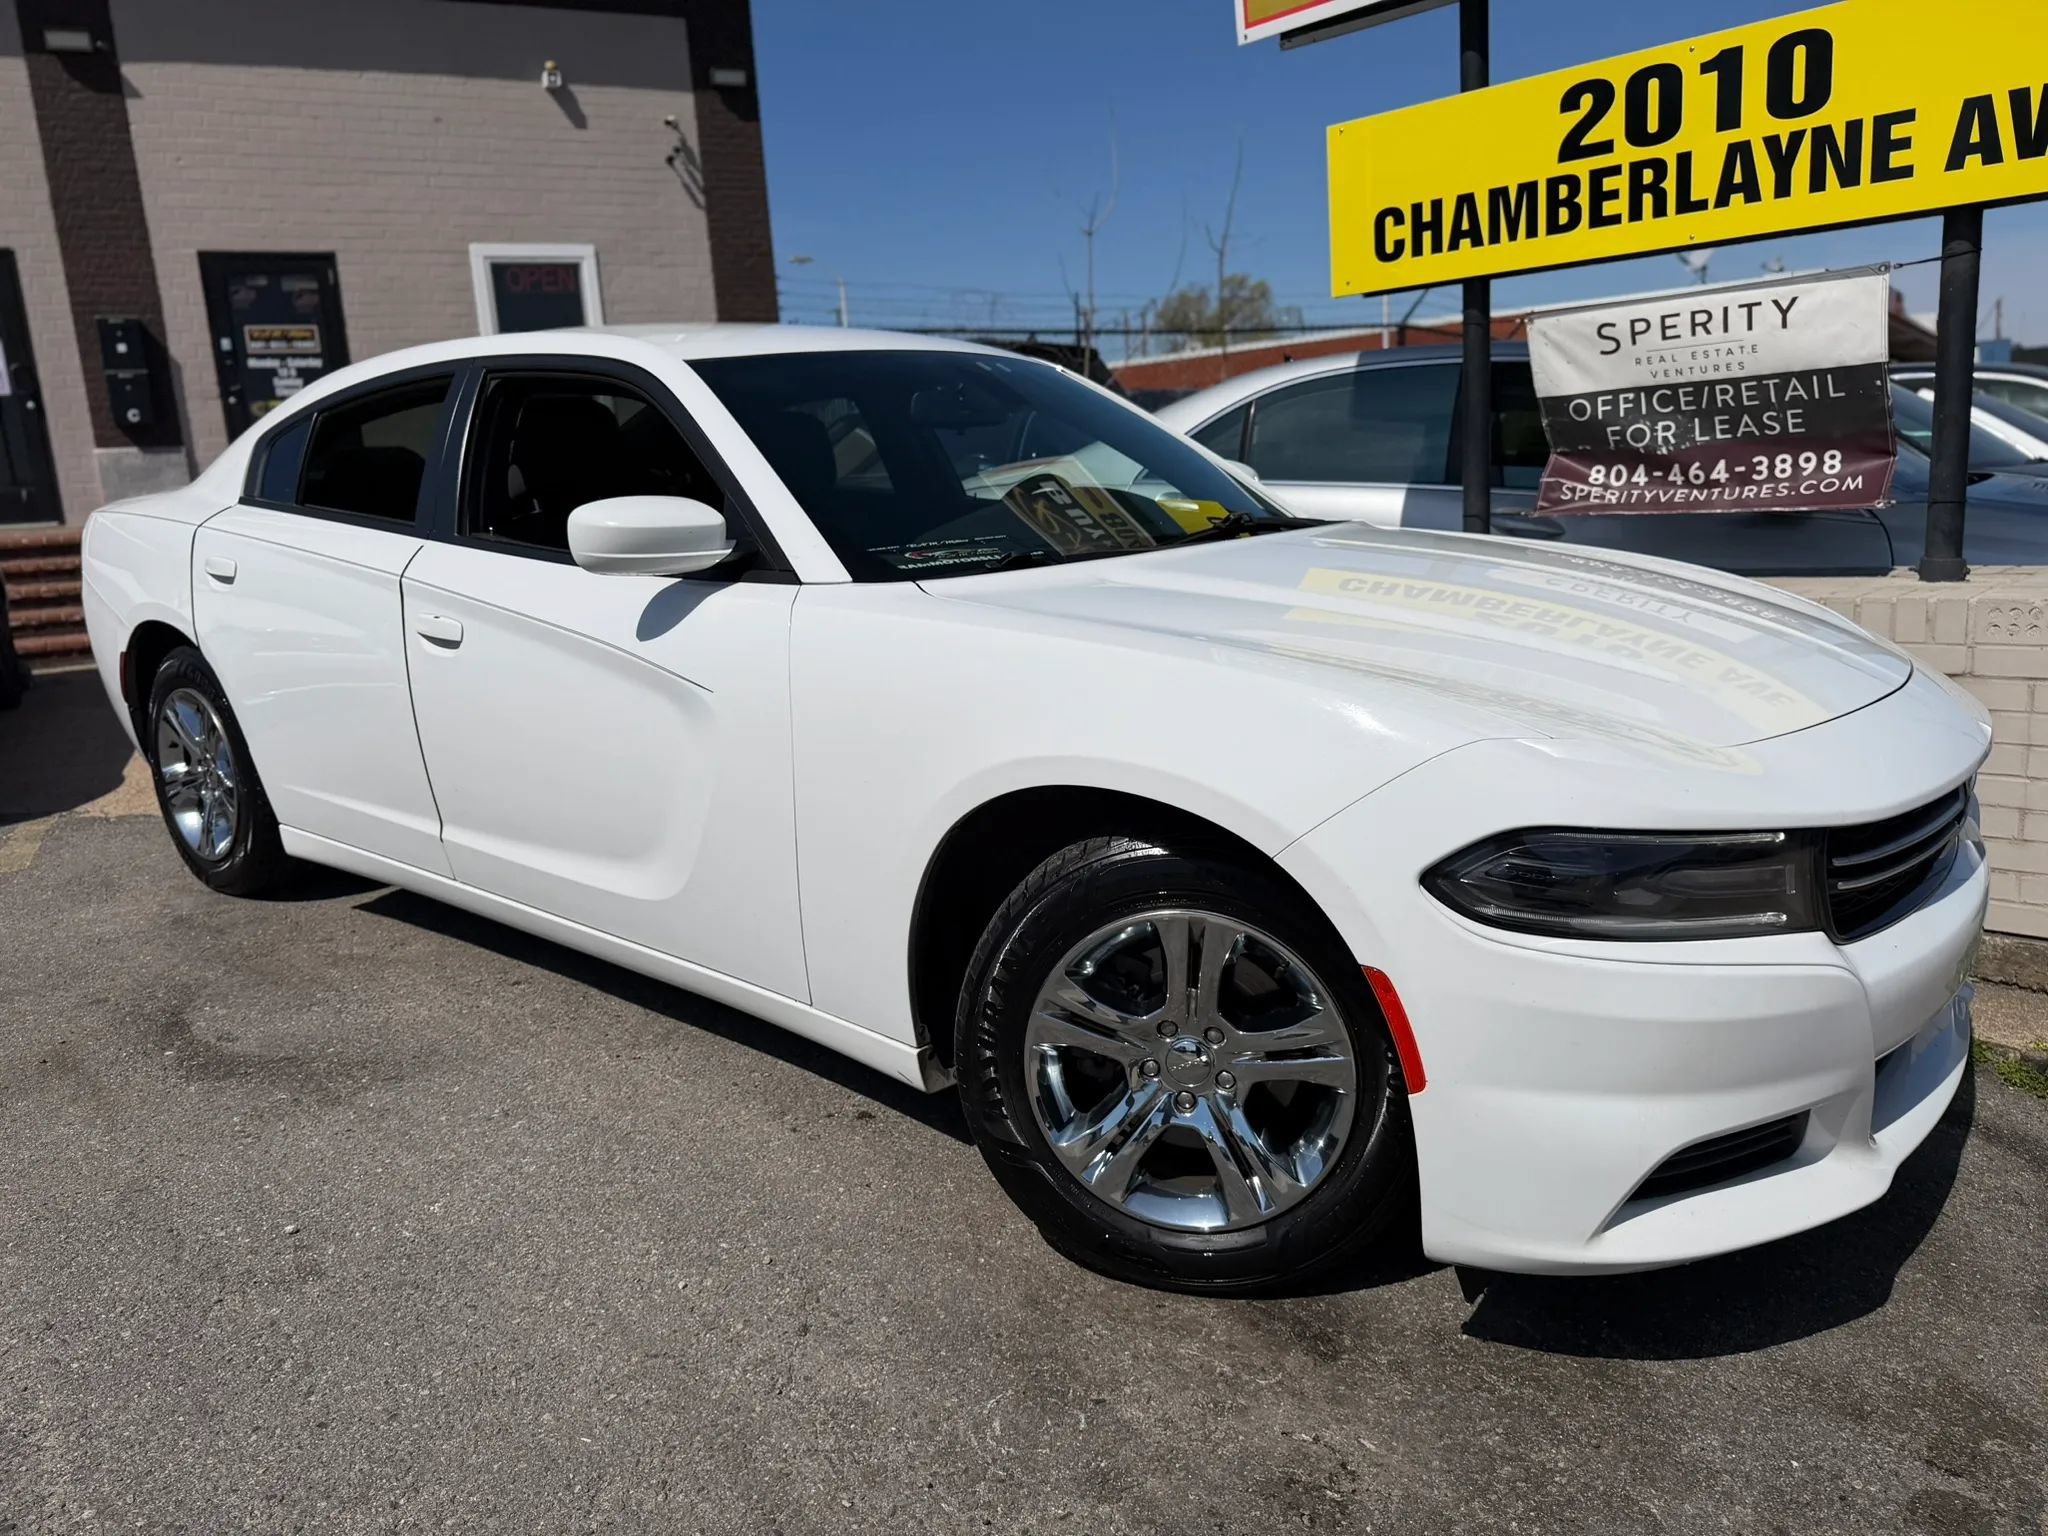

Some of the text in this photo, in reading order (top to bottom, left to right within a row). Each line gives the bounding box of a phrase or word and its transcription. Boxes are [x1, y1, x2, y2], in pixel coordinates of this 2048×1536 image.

[1557, 28, 1834, 164] 2010
[1373, 107, 1917, 264] CHAMBERLAYNE
[507, 267, 576, 291] OPEN
[1596, 296, 1799, 355] SPERITY
[1634, 344, 1759, 366] REAL ESTATE
[1650, 361, 1746, 379] VENTURES
[1568, 373, 1846, 422] OFFICE/RETAIL
[1606, 409, 1806, 448] FOR LEASE
[1588, 449, 1842, 488] 804-464-3898
[1560, 475, 1863, 504] SPERITYVENTURES.COM
